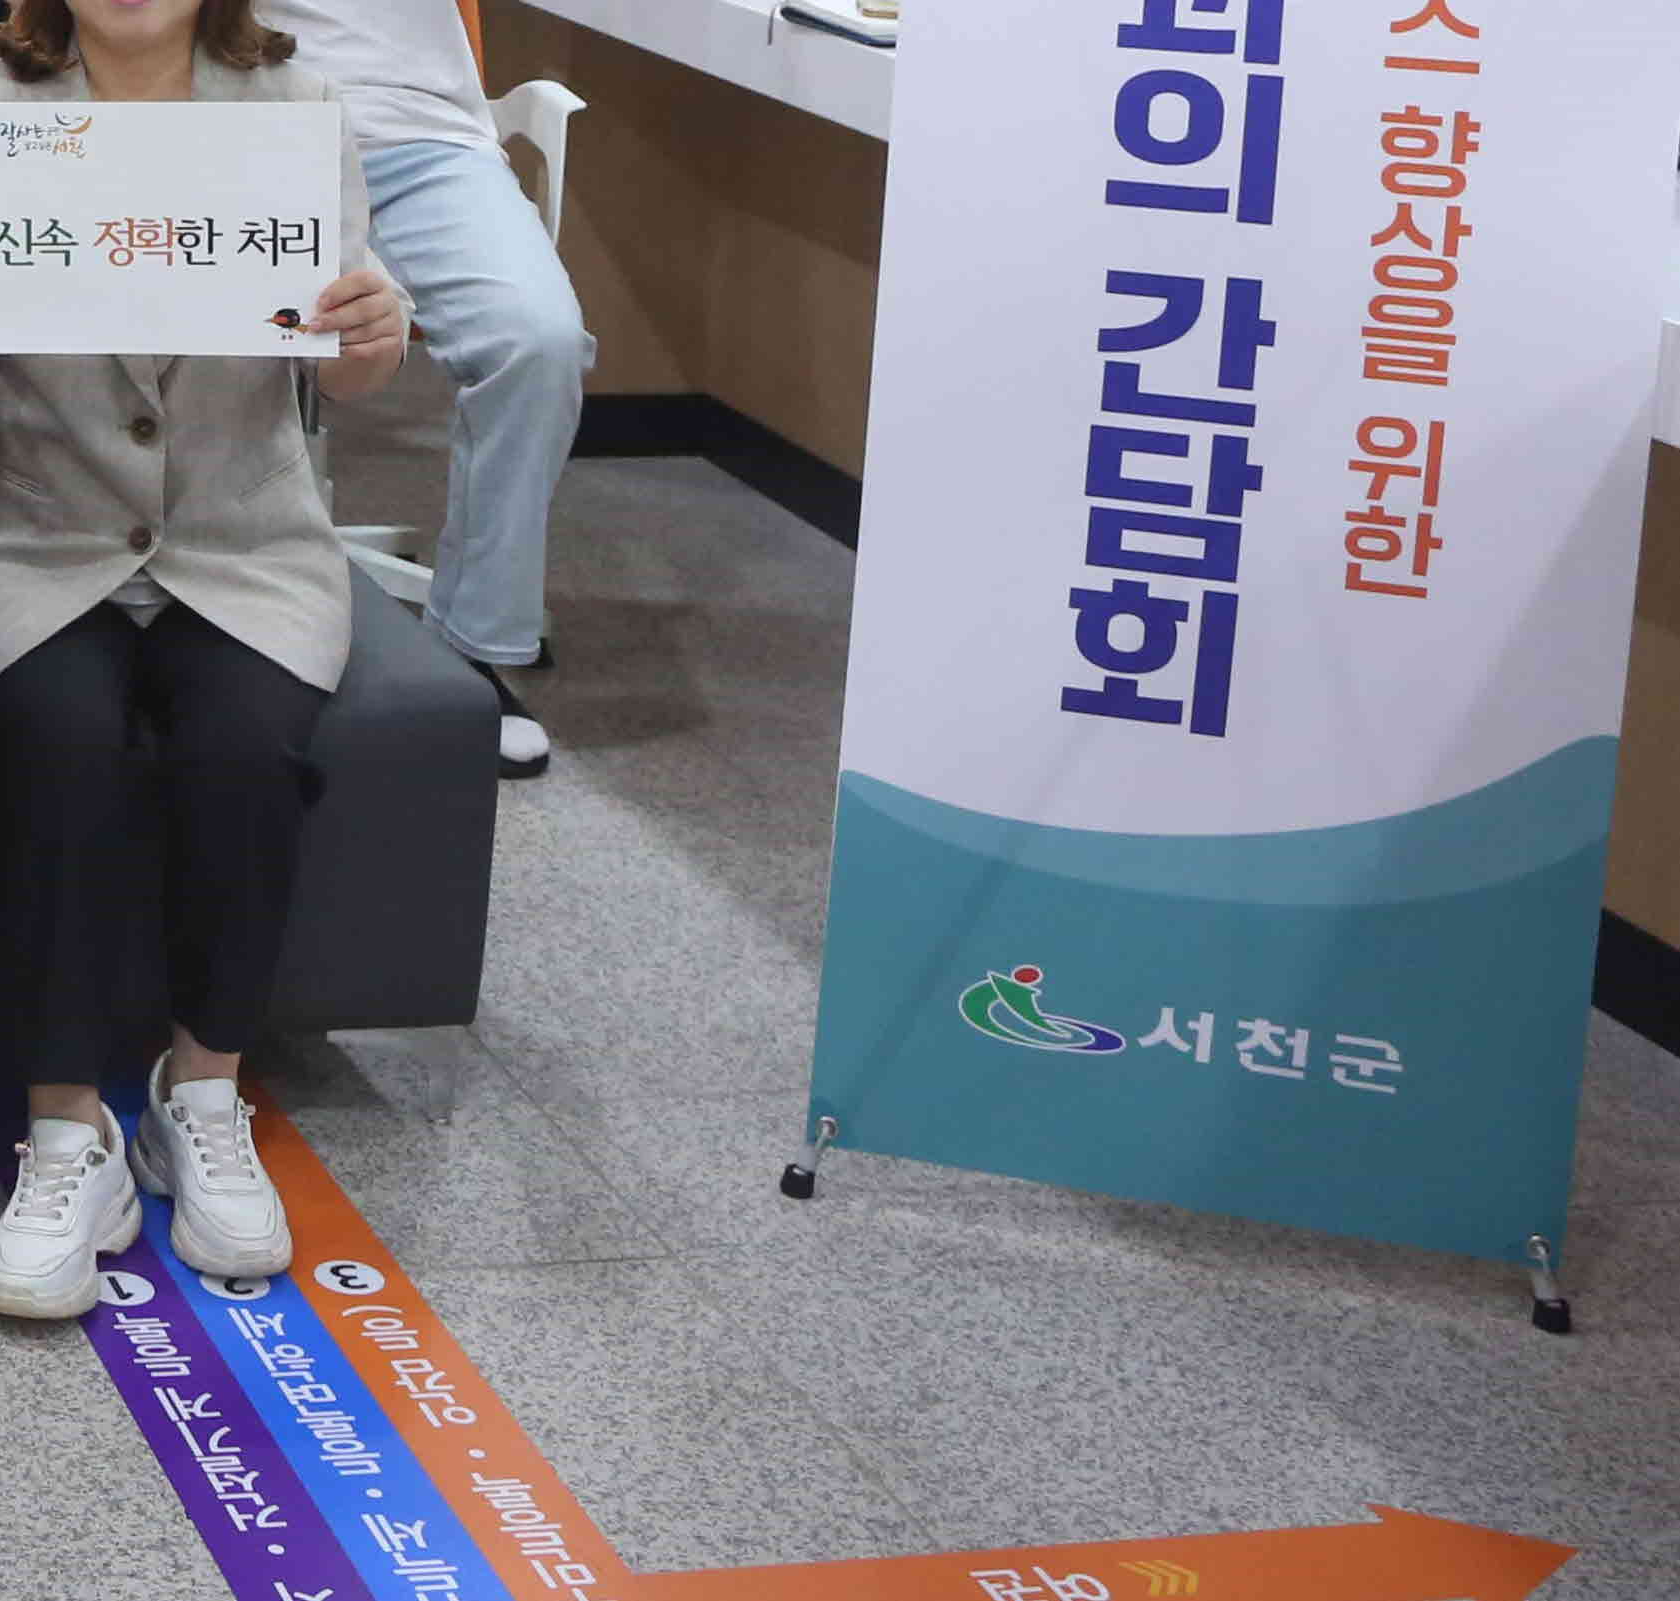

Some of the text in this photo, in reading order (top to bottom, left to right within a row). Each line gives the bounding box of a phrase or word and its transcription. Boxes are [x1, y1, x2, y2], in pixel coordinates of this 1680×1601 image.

[92, 216, 224, 268] 정확한
[236, 217, 321, 268] 처리
[1360, 105, 1483, 387] 향상을
[1060, 268, 1278, 738] 간담회
[1343, 415, 1447, 599] 위한
[1137, 1005, 1404, 1095] 서천군
[329, 1263, 369, 1291] 3
[112, 1310, 193, 1378] 등록
[225, 1305, 384, 1477] 등록면허세
[389, 1358, 478, 1429] 인감
[153, 1385, 288, 1532] 건설기계
[360, 1512, 462, 1601] 득세
[470, 1471, 600, 1601] 민등록
